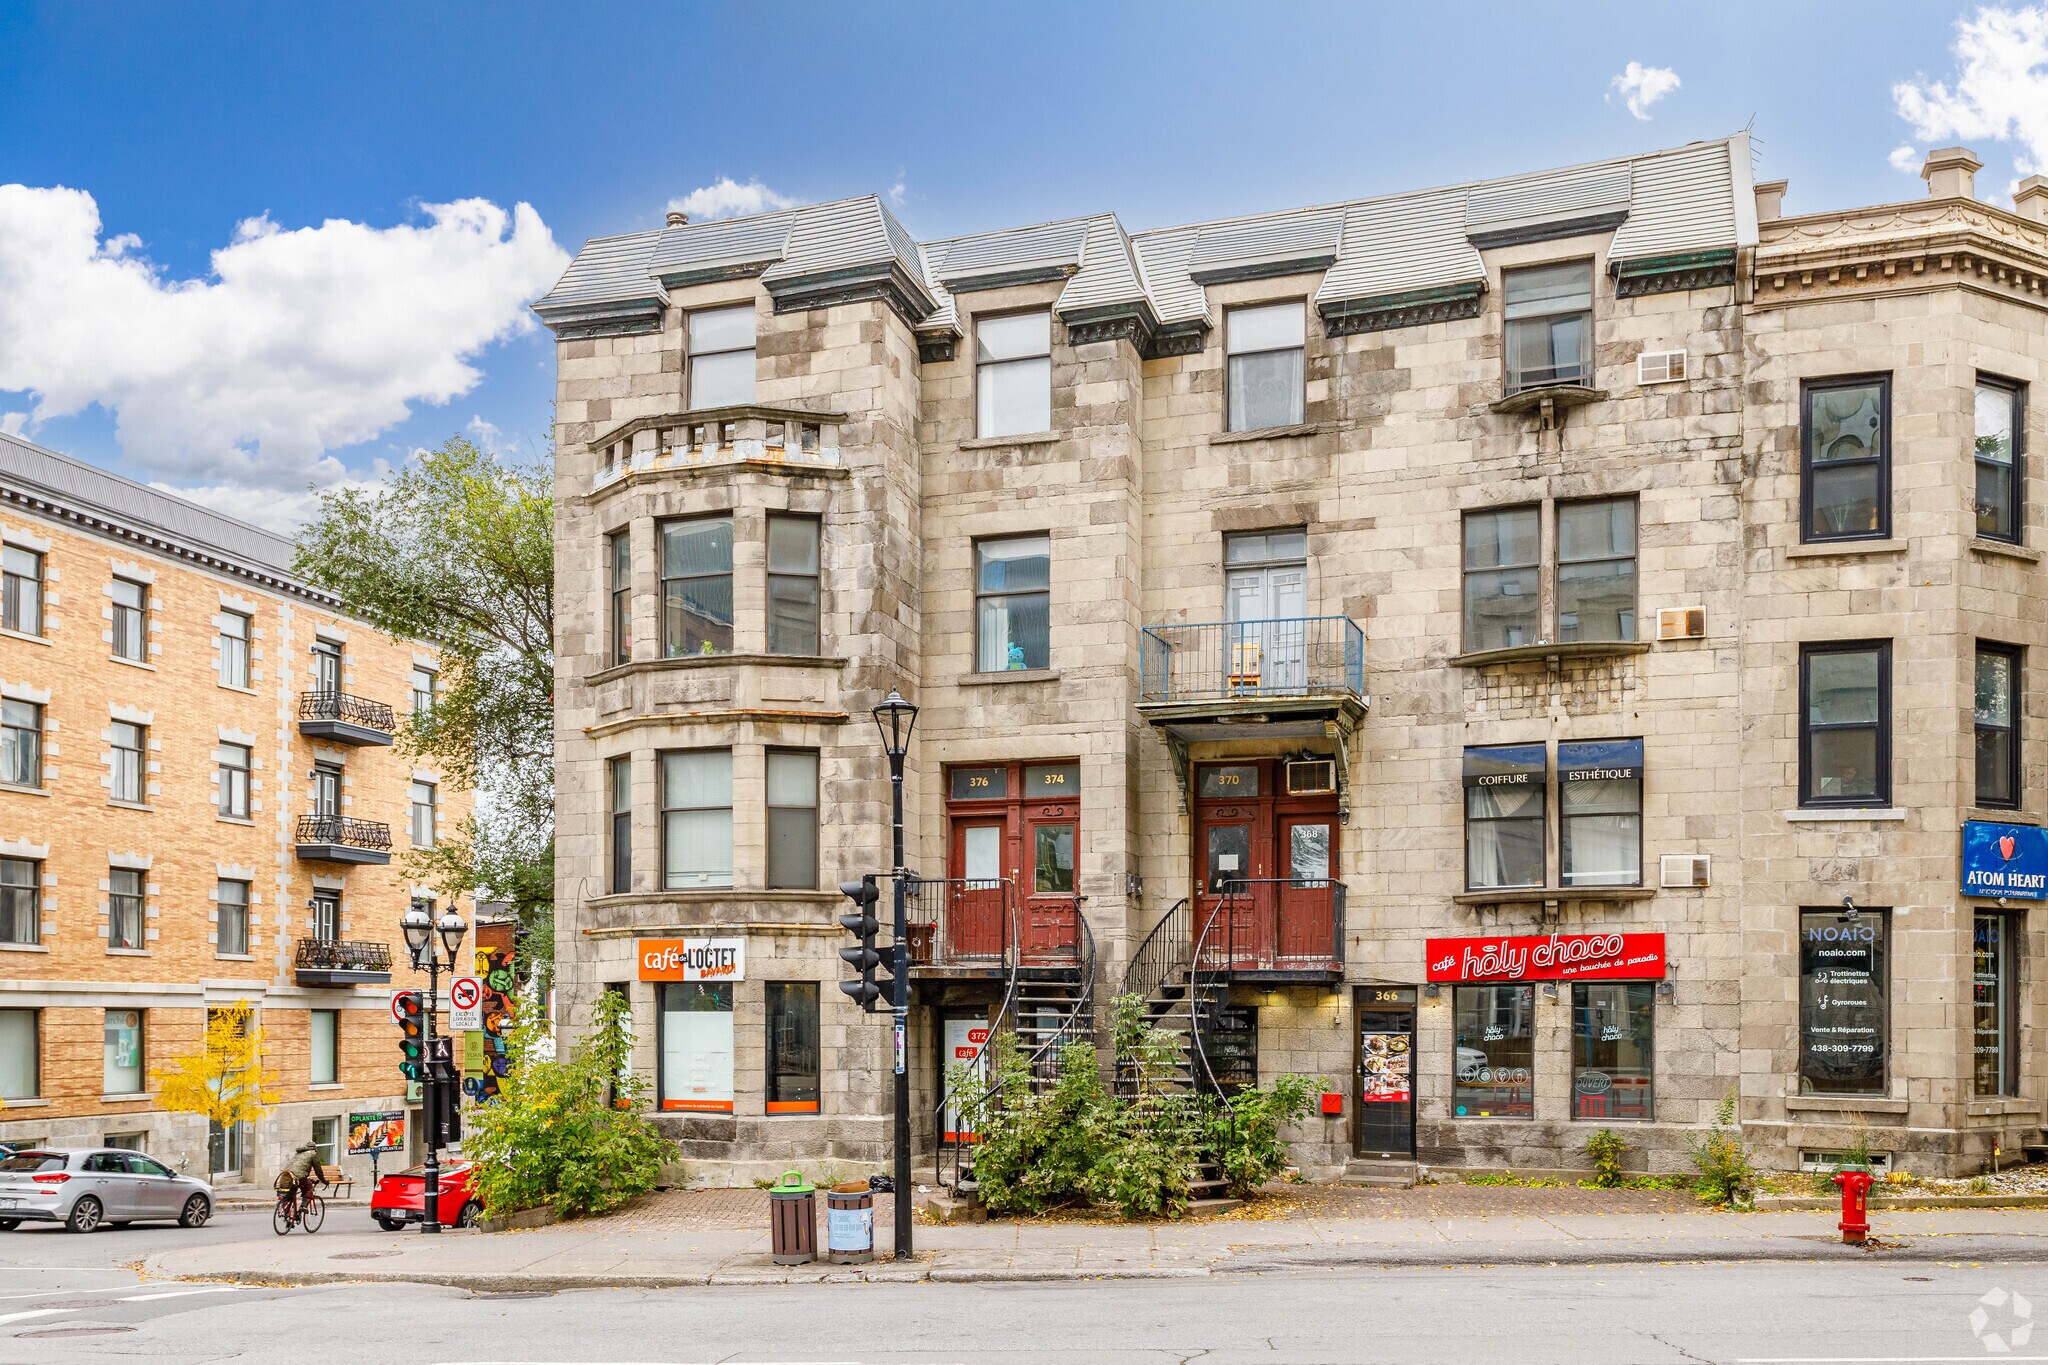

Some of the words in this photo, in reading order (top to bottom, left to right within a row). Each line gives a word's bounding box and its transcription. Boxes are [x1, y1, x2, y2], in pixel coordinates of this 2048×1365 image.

[1044, 774, 1064, 784] 374
[1569, 767, 1632, 781] ESTHÉTIQUE
[969, 777, 989, 787] 376
[1219, 775, 1240, 785] 370
[1478, 774, 1528, 786] COIFFURE
[1300, 830, 1318, 838] 368
[1967, 870, 2004, 886] ATOM
[2008, 873, 2046, 888] HEART
[1809, 927, 1876, 941] NOAIO
[1432, 955, 1456, 971] café
[1532, 932, 1624, 967] choco
[1818, 949, 1867, 957] noaio.com
[644, 947, 679, 971] café
[679, 954, 687, 962] de
[688, 947, 737, 969] L'OCTET
[1580, 960, 1612, 972] bouchée
[1627, 953, 1659, 966] paradis
[1830, 978, 1868, 986] électriques
[1375, 991, 1398, 1001] 366
[1832, 999, 1867, 1007] Gyroroues
[1838, 1026, 1874, 1034] Réparation
[971, 1032, 987, 1040] 372
[1601, 1033, 1623, 1042] choco
[958, 1049, 973, 1058] café
[1811, 1045, 1874, 1053] 438-309-7799
[1576, 1078, 1609, 1088] OUVERT
[351, 1114, 376, 1122] OPLANTE
